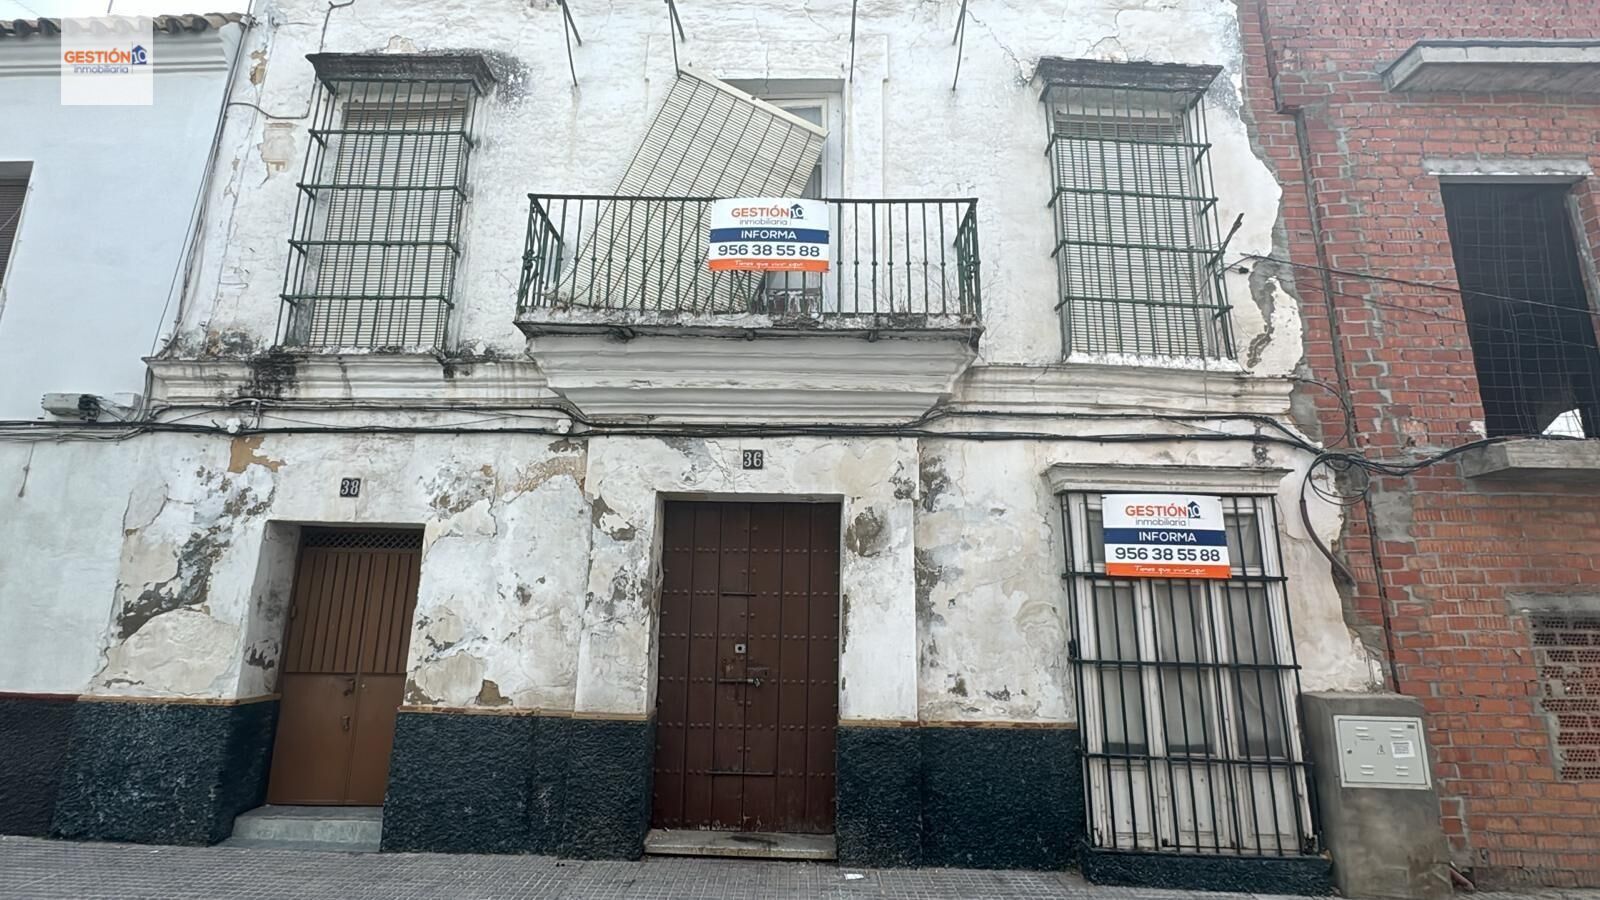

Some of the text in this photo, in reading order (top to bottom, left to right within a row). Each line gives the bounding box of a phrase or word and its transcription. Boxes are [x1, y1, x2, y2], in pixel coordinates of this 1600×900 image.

[731, 205, 789, 218] GESTIÓN
[740, 218, 788, 226] inmobiliaria
[741, 230, 797, 240] INFORMA
[718, 244, 820, 257] 956 38 55 88
[744, 451, 762, 467] 36
[341, 480, 359, 495] 38
[1125, 503, 1187, 517] GESTIÓN
[1136, 518, 1187, 526] inmobiliaria
[1139, 532, 1197, 542] INFORMA
[1115, 547, 1221, 562] 956 38 55 88
